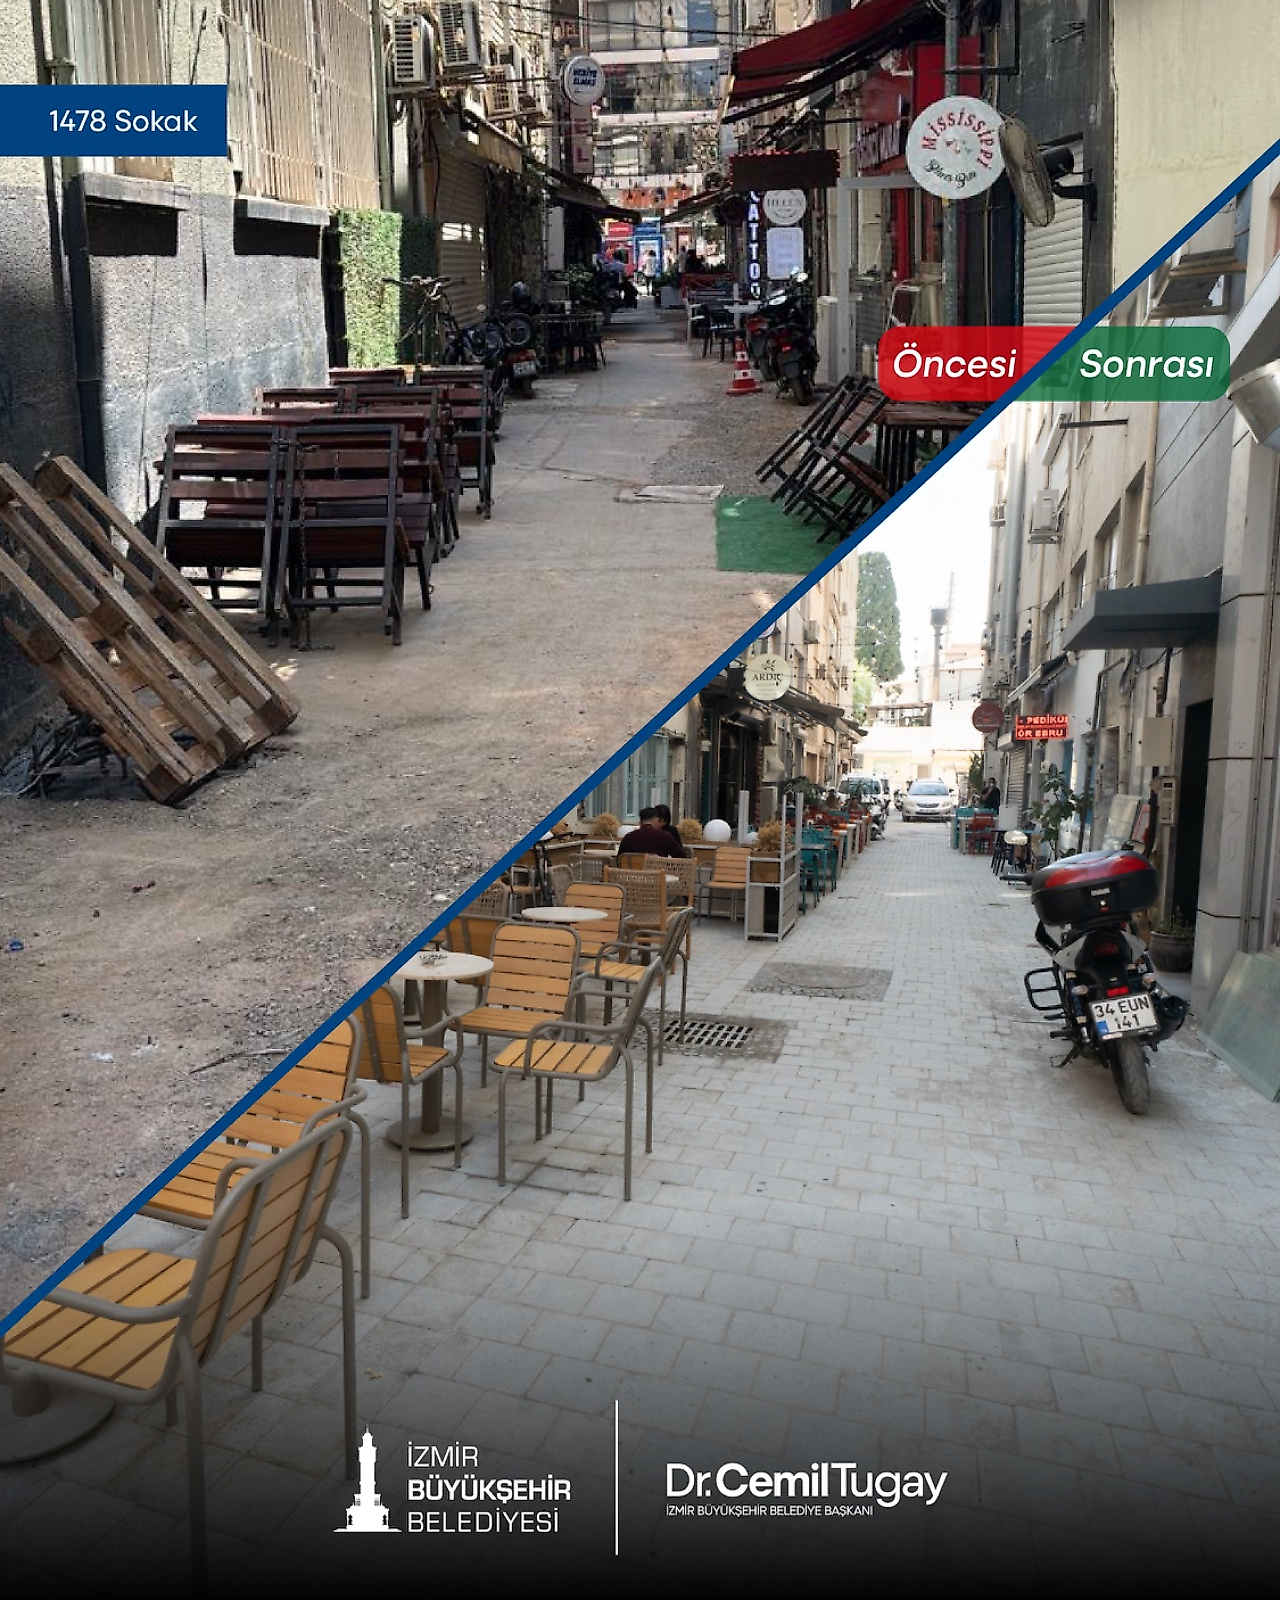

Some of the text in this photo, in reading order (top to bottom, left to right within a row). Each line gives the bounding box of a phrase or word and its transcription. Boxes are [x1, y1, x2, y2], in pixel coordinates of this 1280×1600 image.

[1094, 997, 1149, 1017] 34 EUN
[1115, 1014, 1139, 1029] 141
